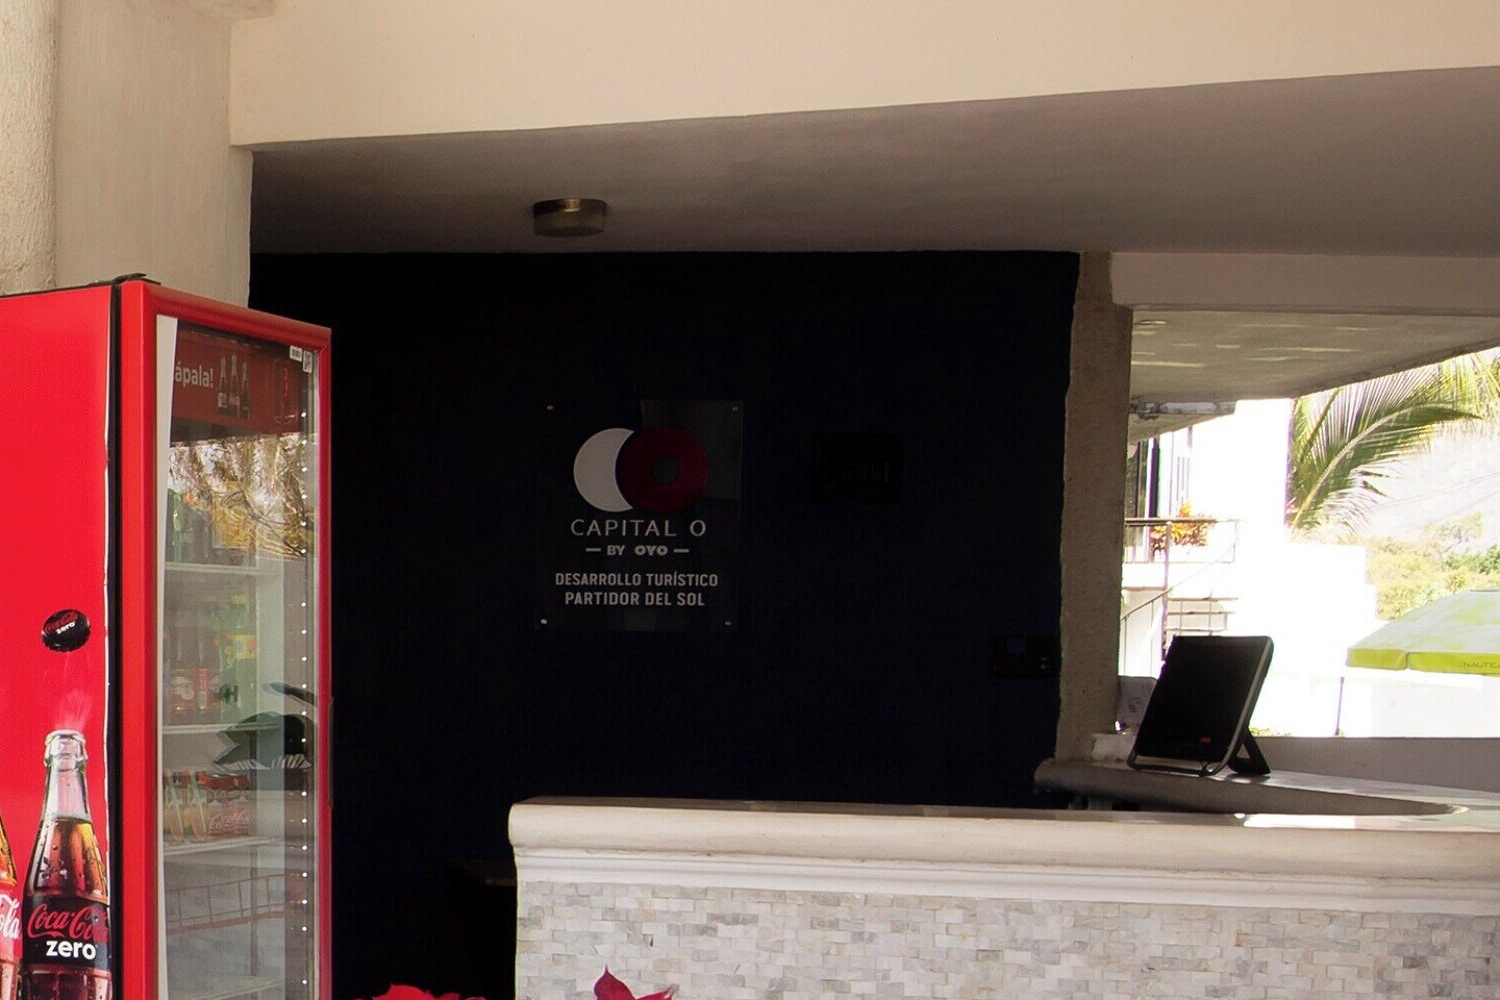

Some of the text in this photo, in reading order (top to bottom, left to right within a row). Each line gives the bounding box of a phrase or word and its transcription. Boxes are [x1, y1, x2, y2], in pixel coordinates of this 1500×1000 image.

[570, 519, 707, 537] CAPITAL O
[606, 545, 668, 556] BY OYO
[555, 571, 719, 587] DESARROLLO TURÍSTICO
[565, 591, 705, 607] PARTIDOR DEL SOL
[55, 620, 76, 635] zero
[27, 903, 108, 944] Coca-Cola
[46, 940, 97, 960] zero
